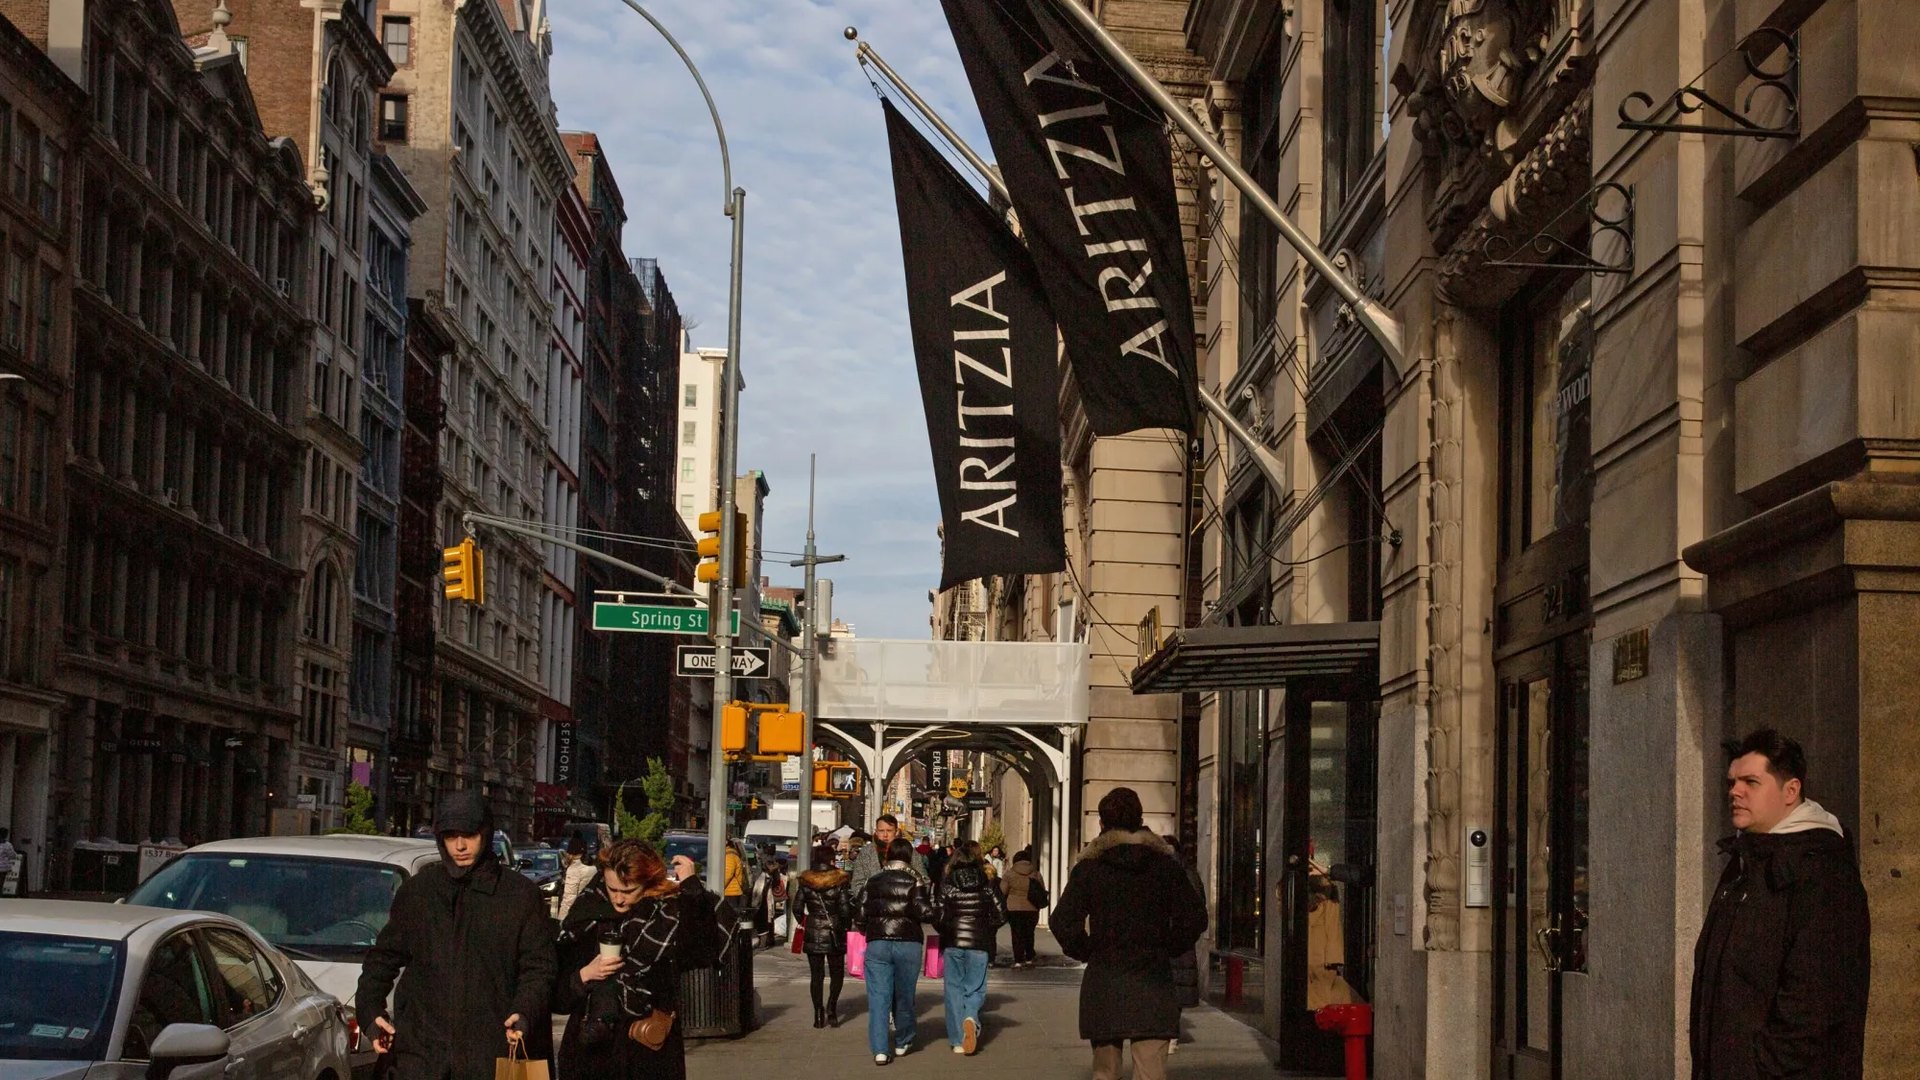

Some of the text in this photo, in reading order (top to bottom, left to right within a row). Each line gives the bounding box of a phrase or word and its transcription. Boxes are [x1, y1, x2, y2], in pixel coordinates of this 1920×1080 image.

[1023, 50, 1180, 379] ARITZIA
[950, 269, 1020, 538] ARITZIA
[631, 611, 702, 630] Spring St
[691, 655, 756, 669] ONE WAY
[558, 722, 571, 783] SEPHORA
[932, 750, 942, 787] EPUBLIC
